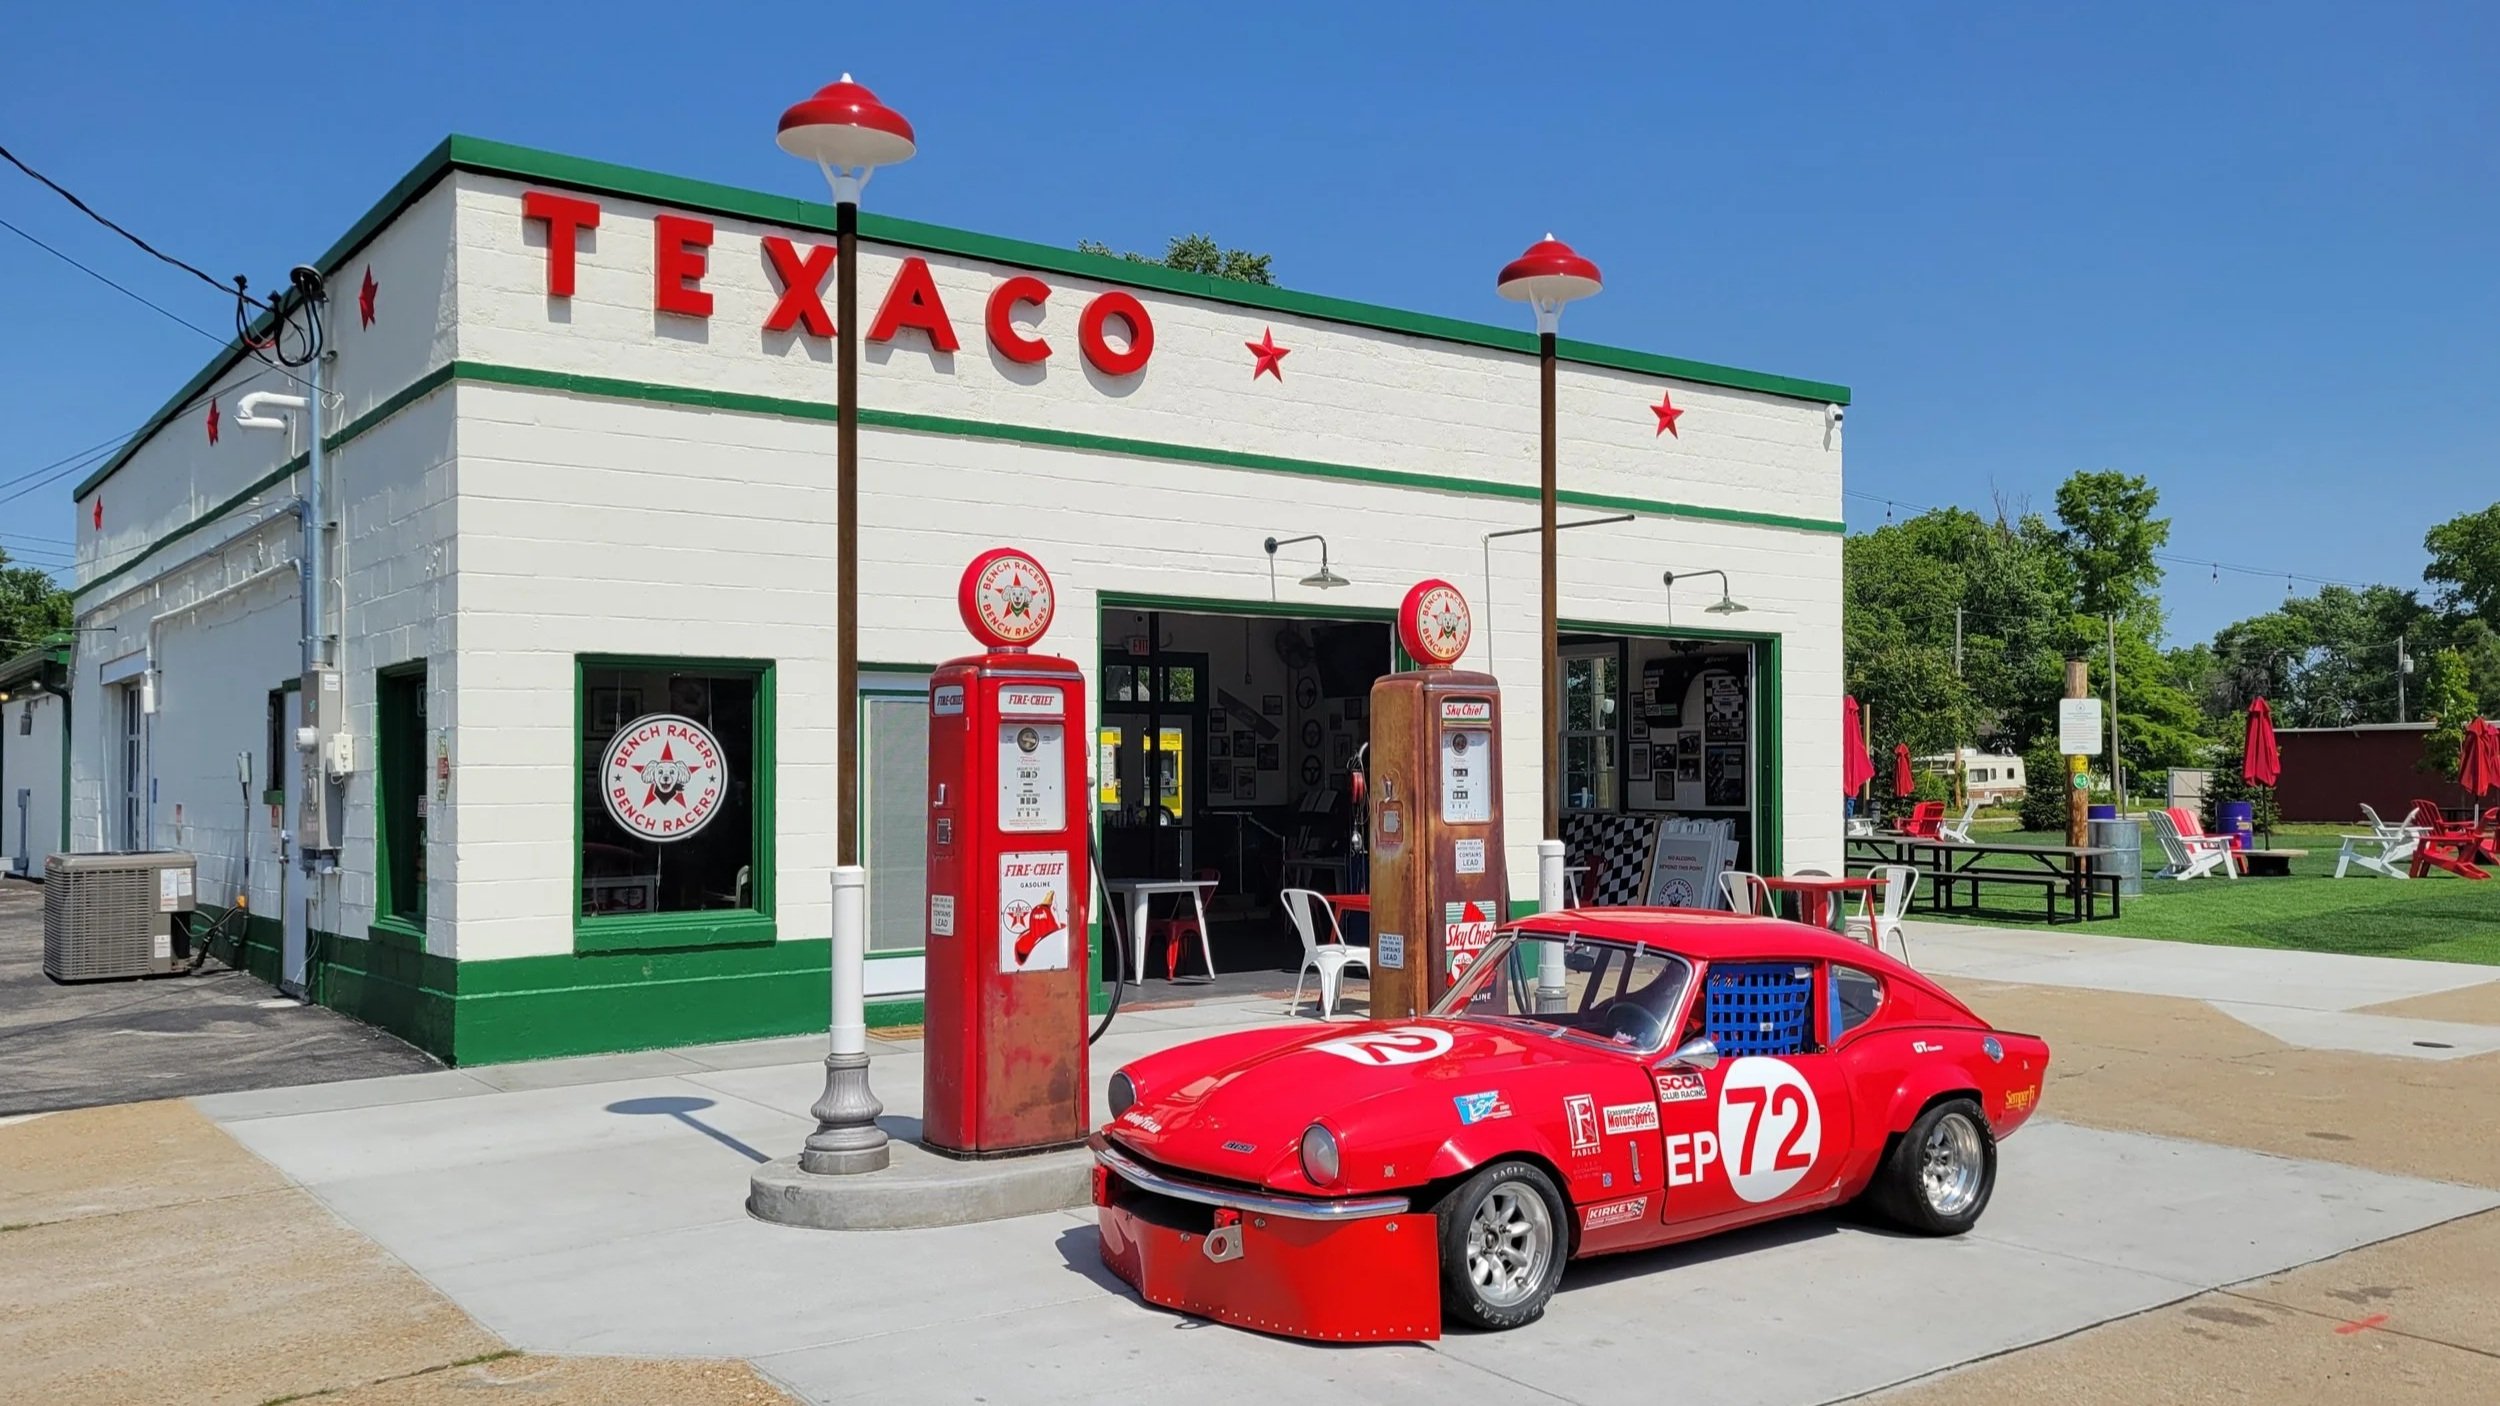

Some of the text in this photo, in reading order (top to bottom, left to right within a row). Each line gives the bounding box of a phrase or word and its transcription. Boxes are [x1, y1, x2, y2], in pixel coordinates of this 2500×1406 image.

[522, 191, 1154, 375] TEXACO
[983, 562, 1046, 594] BENCH RACERS
[1423, 591, 1442, 616] BENCH
[983, 603, 1047, 636] BENCH RACERS
[1423, 627, 1443, 654] BENCH
[1008, 694, 1054, 706] FIRE-CHIEF
[1446, 704, 1484, 717] Sky Chief
[614, 724, 717, 769] BENCH RACERS
[613, 787, 716, 832] BENCH RACERS
[1005, 863, 1064, 877] FIRE-CHIEF
[1462, 859, 1479, 867] LEAD
[1020, 881, 1050, 889] GASOLINE
[935, 919, 949, 927] LEAD
[1446, 922, 1497, 951] Sky Chief
[1383, 953, 1398, 961] LEAD
[1659, 1075, 1704, 1091] SCCA
[1661, 1087, 1706, 1101] CLUB RACING
[2005, 1089, 2030, 1111] Semper
[1608, 1111, 1657, 1129] Motorsports
[1725, 1083, 1811, 1176] 72
[1572, 1146, 1602, 1158] FABLES
[1666, 1131, 1719, 1187] EP
[1492, 1167, 1525, 1181] EAGLE
[1590, 1202, 1635, 1219] KIRKEY
